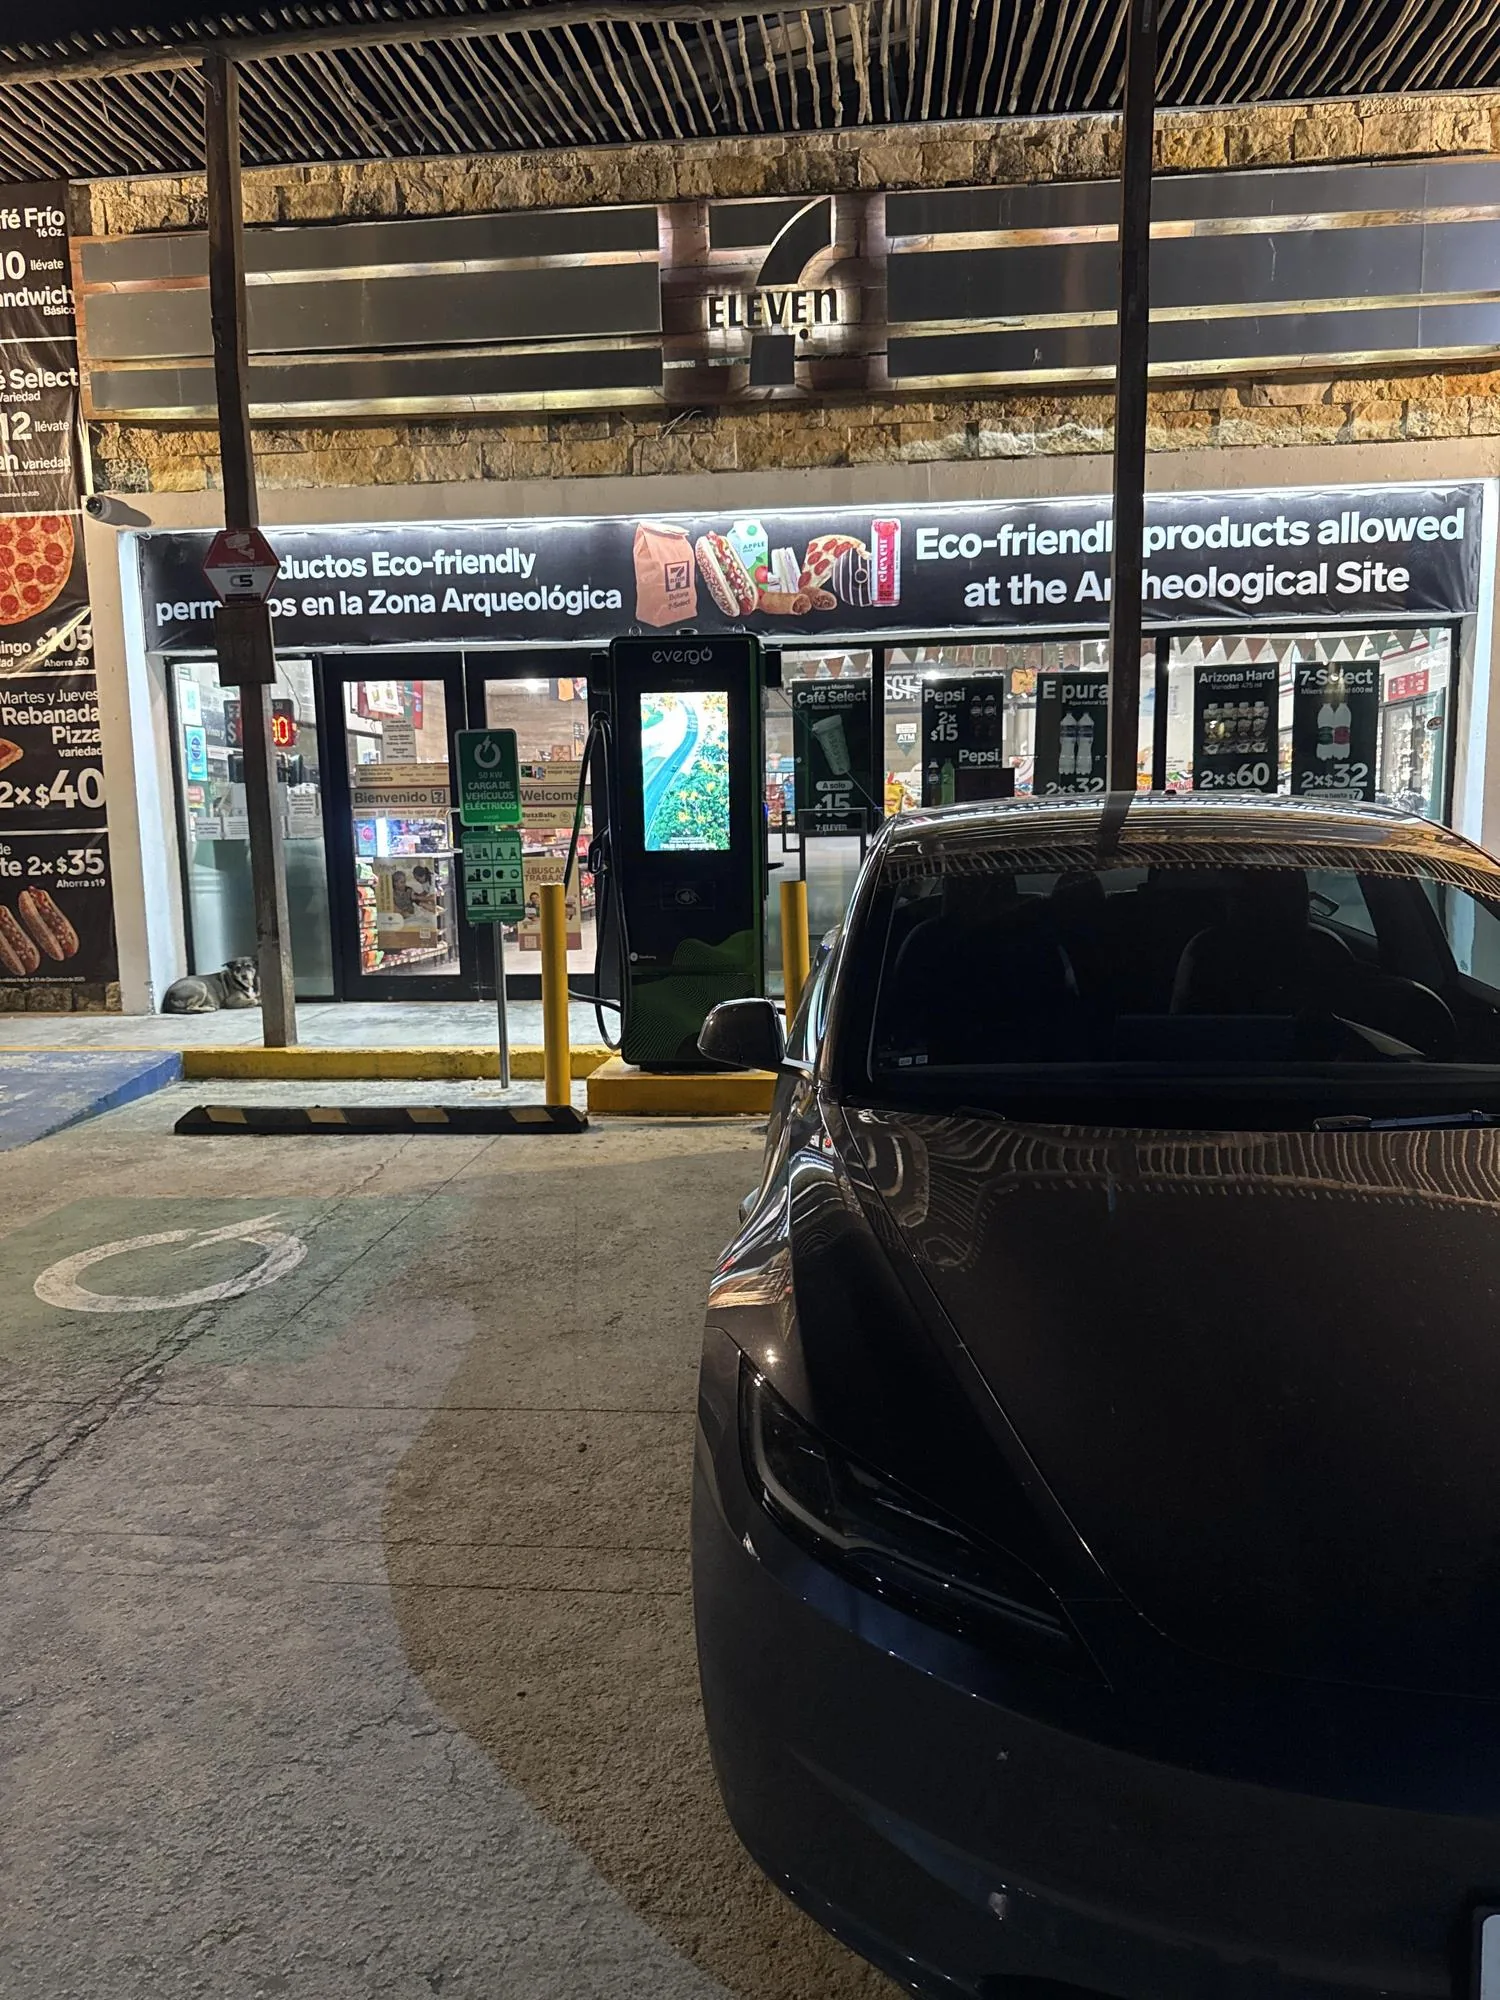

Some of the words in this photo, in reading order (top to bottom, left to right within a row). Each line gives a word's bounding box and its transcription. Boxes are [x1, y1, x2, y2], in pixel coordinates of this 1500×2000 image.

[0, 208, 21, 230] fé
[24, 206, 65, 228] Frío
[36, 228, 48, 238] 16
[48, 227, 65, 237] Oz.
[30, 259, 64, 271] llévate
[0, 285, 76, 308] ndwich
[43, 305, 76, 316] Básico
[9, 367, 79, 390] Select
[34, 420, 70, 432] llévate
[22, 455, 71, 470] variedad
[915, 519, 1114, 561] Eco-friendl
[1142, 515, 1310, 558] products
[1317, 507, 1466, 545] allowed
[277, 553, 368, 581] ductos
[371, 547, 537, 579] Eco-friendly
[963, 575, 1001, 608] at
[1006, 572, 1068, 605] the
[1073, 563, 1329, 605] Arheological
[1335, 560, 1410, 594] Site
[155, 596, 298, 627] permos
[301, 596, 335, 616] en
[340, 590, 364, 615] la
[367, 589, 436, 615] Zona
[441, 584, 622, 618] Arqueológica
[0, 640, 32, 657] ingo
[44, 659, 73, 667] Ahorra
[1199, 671, 1240, 684] Arizona
[1245, 668, 1276, 681] Hard
[0, 690, 45, 705] Martes
[46, 692, 55, 706] y
[57, 688, 98, 703] Jueves
[797, 691, 826, 704] Café
[828, 690, 868, 703] Select
[924, 687, 966, 704] Pepsi
[1043, 680, 1057, 699] E
[1061, 684, 1109, 704] pura
[1, 703, 100, 726] Rebanada
[938, 711, 957, 724] 2x
[51, 725, 102, 745] Pizza
[897, 733, 916, 742] ATM
[930, 723, 959, 742] $15
[958, 748, 999, 765] Pepsi
[467, 781, 498, 790] CARGA
[499, 780, 511, 790] DE
[354, 791, 428, 804] Bienvenido
[465, 790, 515, 801] VEHÍCULOS
[464, 801, 518, 811] ELÉCTRICOS
[56, 848, 105, 876] $35
[56, 879, 90, 889] Ahorra
